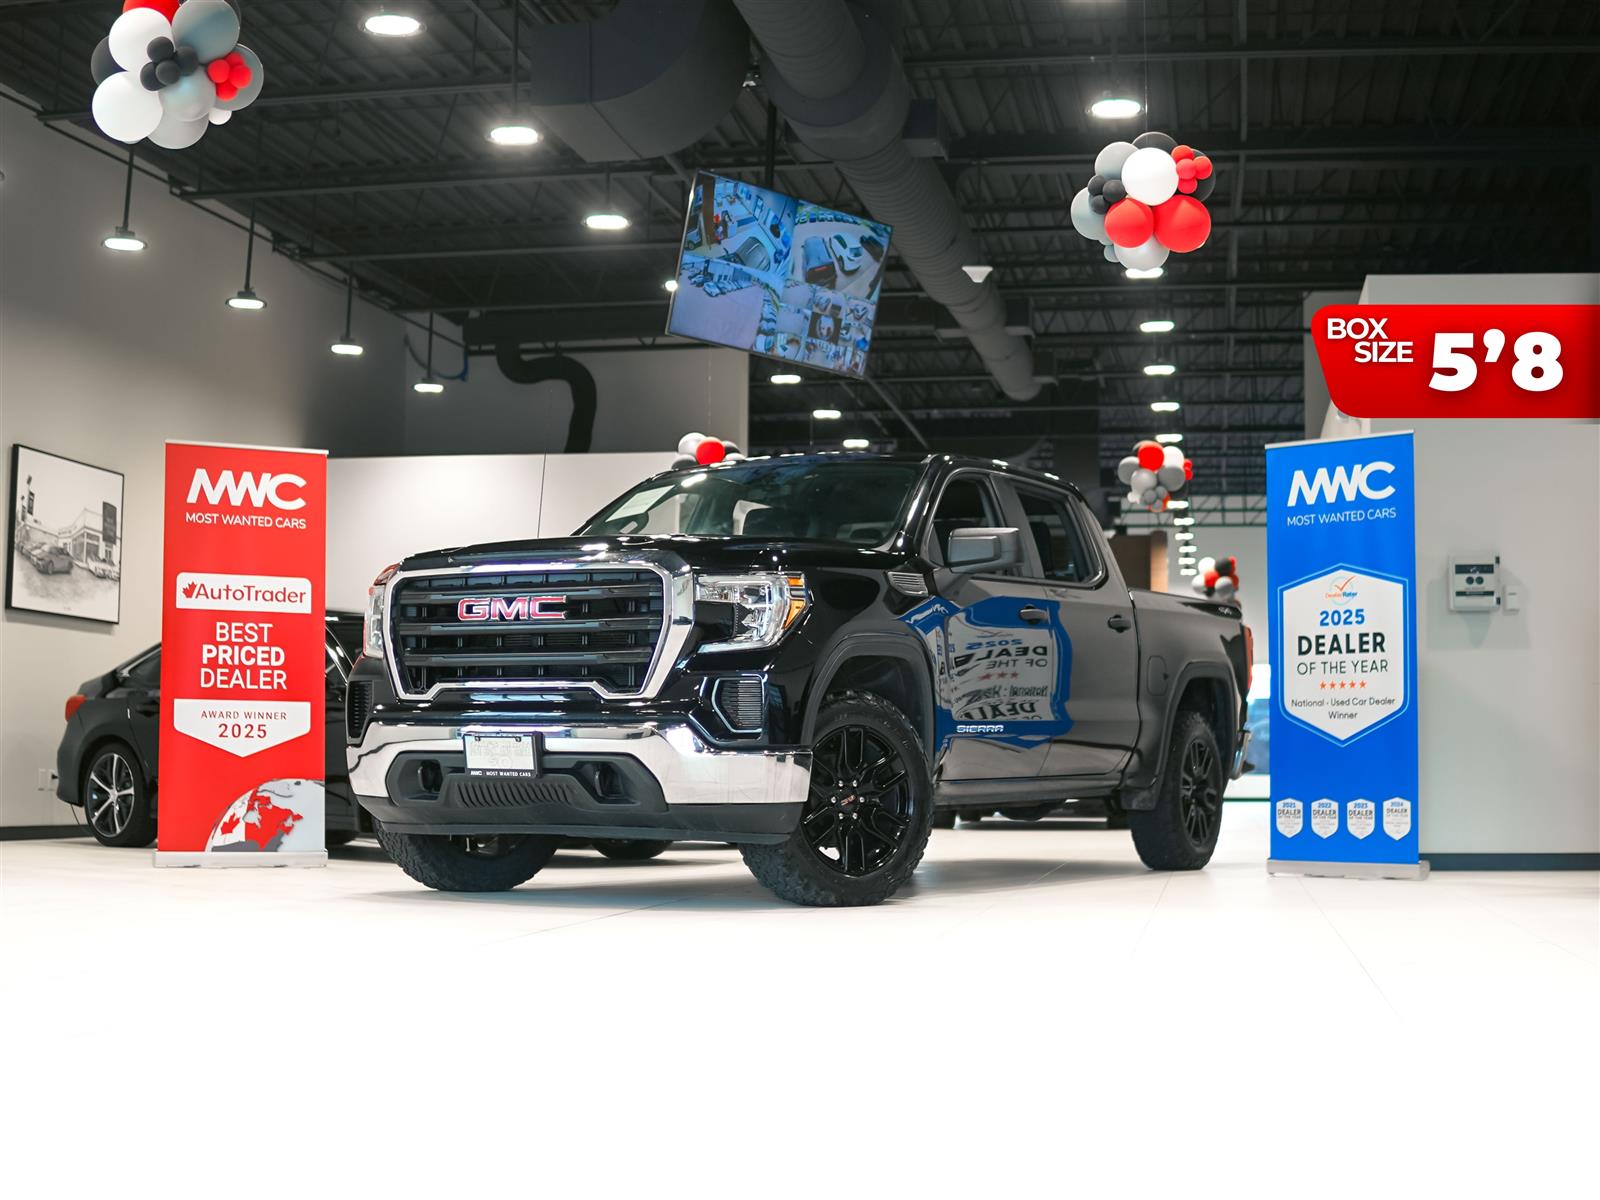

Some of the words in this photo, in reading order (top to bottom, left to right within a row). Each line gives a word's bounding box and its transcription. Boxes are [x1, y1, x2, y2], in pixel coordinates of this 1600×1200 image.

[186, 467, 307, 510] MWC
[1287, 461, 1396, 507] MWC
[185, 512, 219, 525] MOST
[221, 514, 273, 527] WANTED
[275, 517, 307, 529] CARS
[1287, 514, 1316, 527] MOST
[1318, 510, 1365, 524] WANTED
[1367, 507, 1397, 520] CARS
[195, 583, 306, 603] AutoTrader
[458, 595, 567, 620] GMC
[1319, 608, 1365, 627] 2025
[216, 621, 273, 643] BEST
[1298, 632, 1385, 656] DEALER
[202, 644, 285, 666] PRICED
[1297, 661, 1316, 676] OF
[1321, 660, 1346, 675] THE
[1351, 659, 1388, 673] YEAR
[200, 668, 287, 690] DEALER
[1291, 698, 1324, 708] National
[1331, 698, 1350, 706] Used
[1352, 697, 1367, 706] Car
[1369, 696, 1395, 706] Dealer
[201, 710, 240, 719] AWARD
[243, 711, 287, 720] WINNER
[1328, 710, 1357, 719] Winner
[218, 723, 267, 738] 2025
[957, 725, 1004, 733] SIERRA
